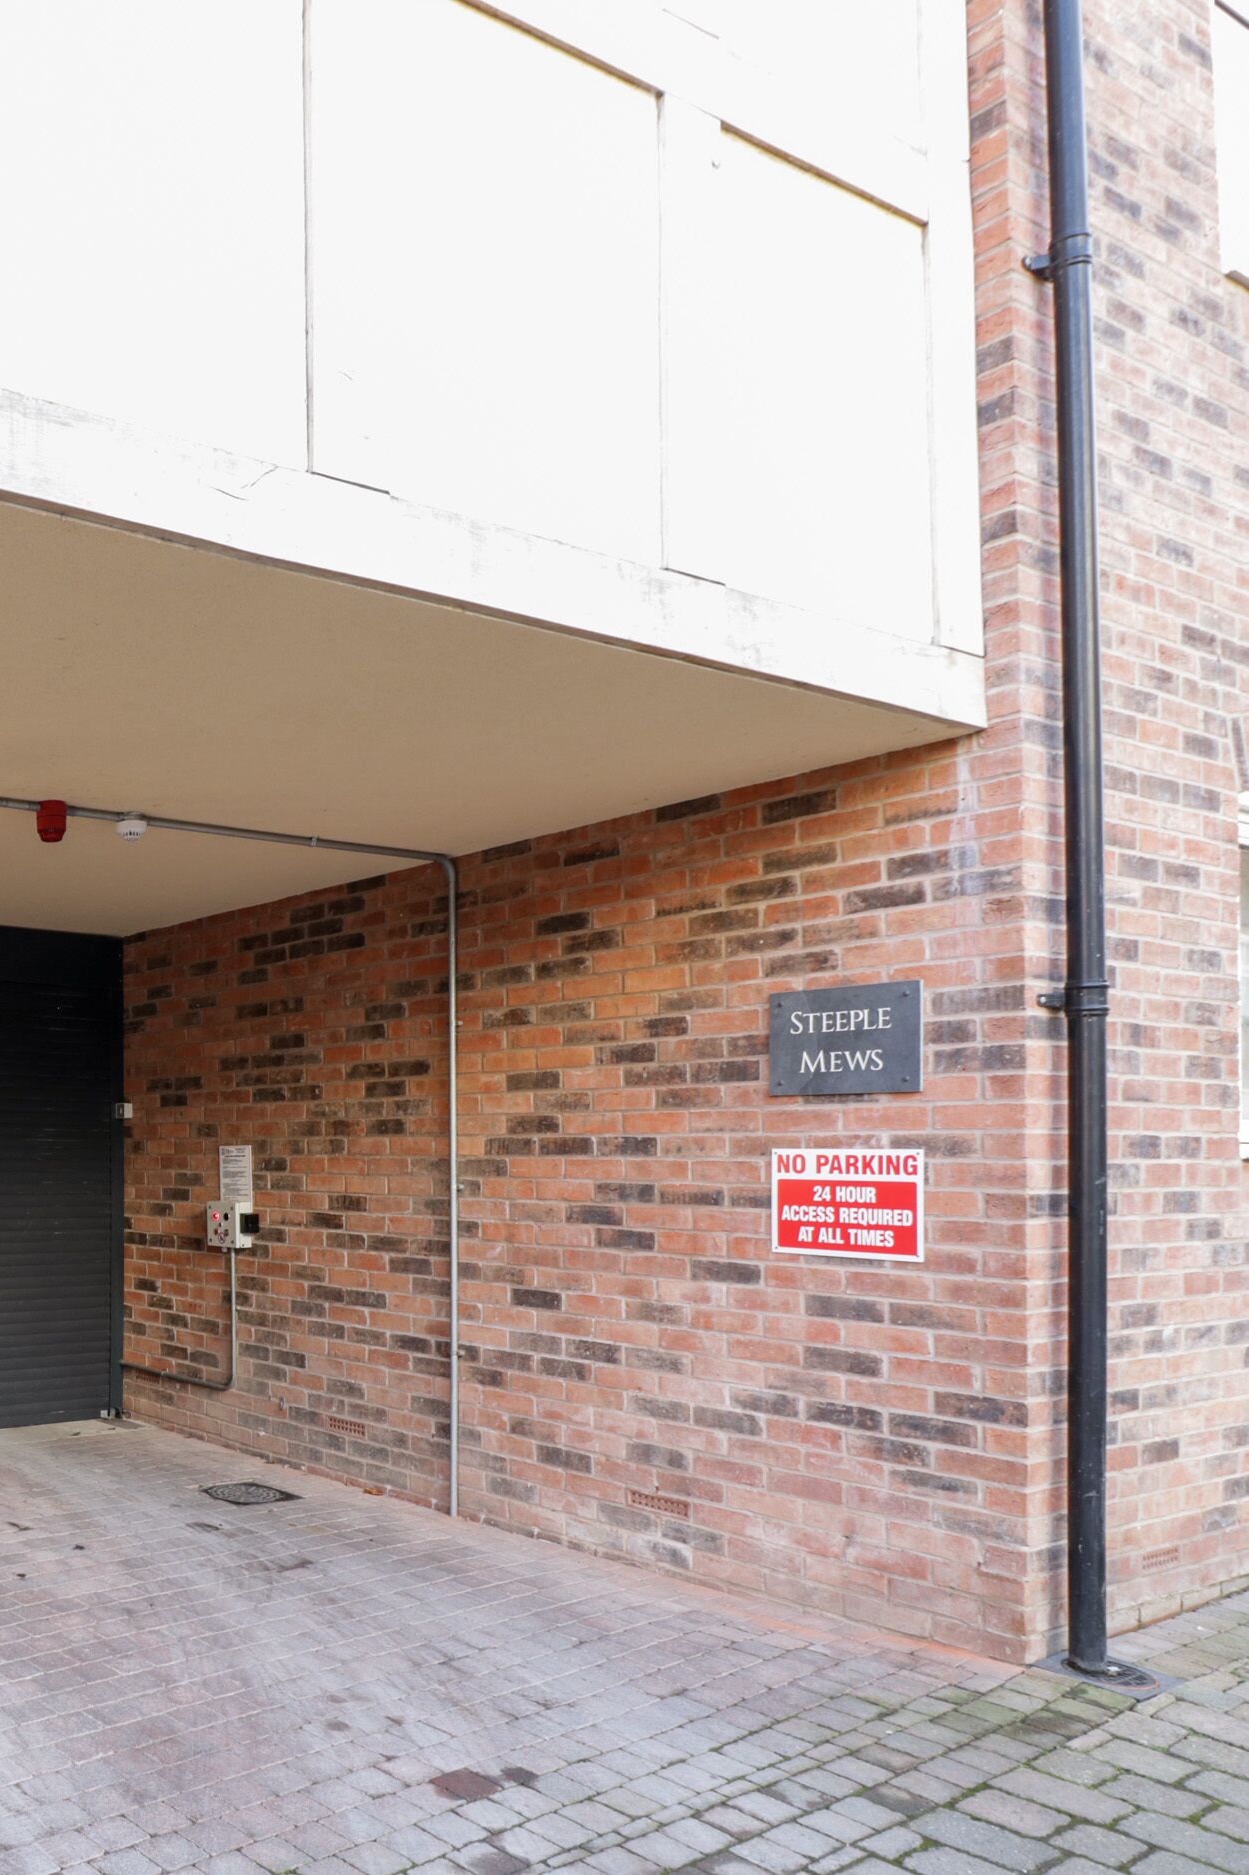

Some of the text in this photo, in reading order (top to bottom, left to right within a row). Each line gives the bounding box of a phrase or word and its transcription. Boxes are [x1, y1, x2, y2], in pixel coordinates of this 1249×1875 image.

[790, 1007, 892, 1035] STEEPLE
[799, 1049, 884, 1074] MEWS
[777, 1154, 918, 1176] NO PARKING
[813, 1185, 876, 1203] 24 HOUR
[781, 1205, 913, 1226] ACCESS REQUIRED
[798, 1226, 894, 1248] AT ALL TIMES
